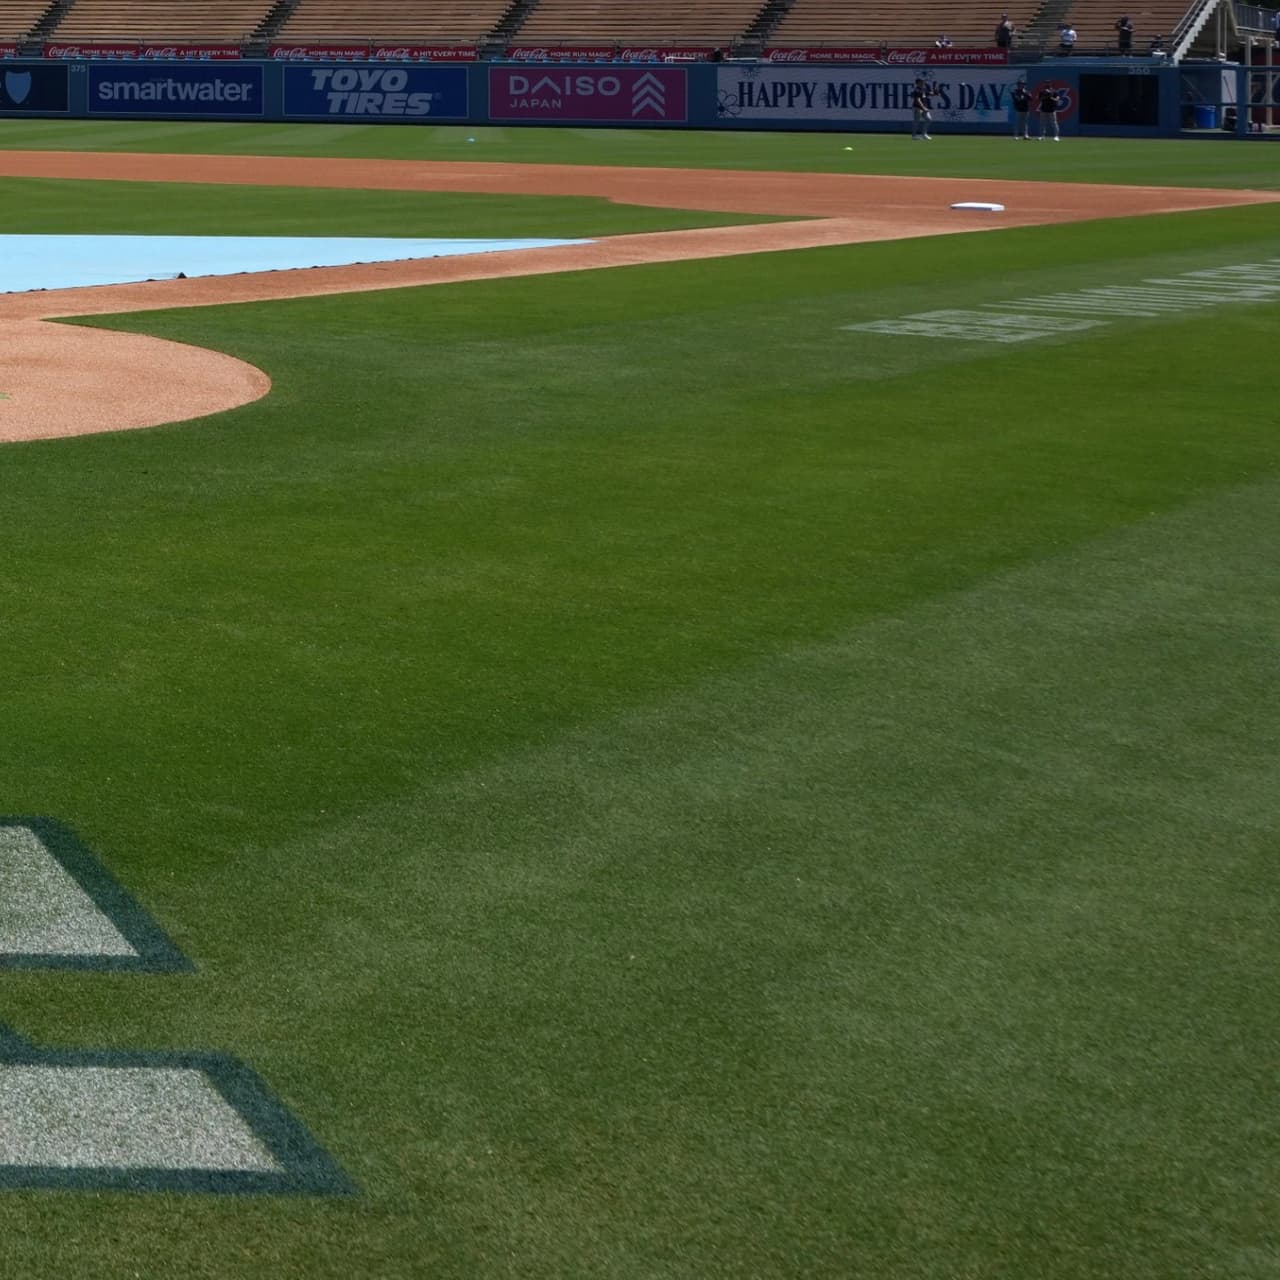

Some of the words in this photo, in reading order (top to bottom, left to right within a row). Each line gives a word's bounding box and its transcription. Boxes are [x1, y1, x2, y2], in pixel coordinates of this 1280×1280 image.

[512, 48, 550, 59] Coca-Cola
[550, 50, 571, 58] HOME
[572, 50, 587, 58] RUN
[587, 50, 612, 58] MAGIC
[97, 78, 254, 102] smartwater
[311, 68, 409, 92] TOYO
[509, 75, 622, 96] DAISO
[326, 92, 433, 116] TIRES
[510, 98, 562, 109] JAPAN
[736, 80, 819, 109] HAPPY
[957, 81, 1007, 111] DAY
